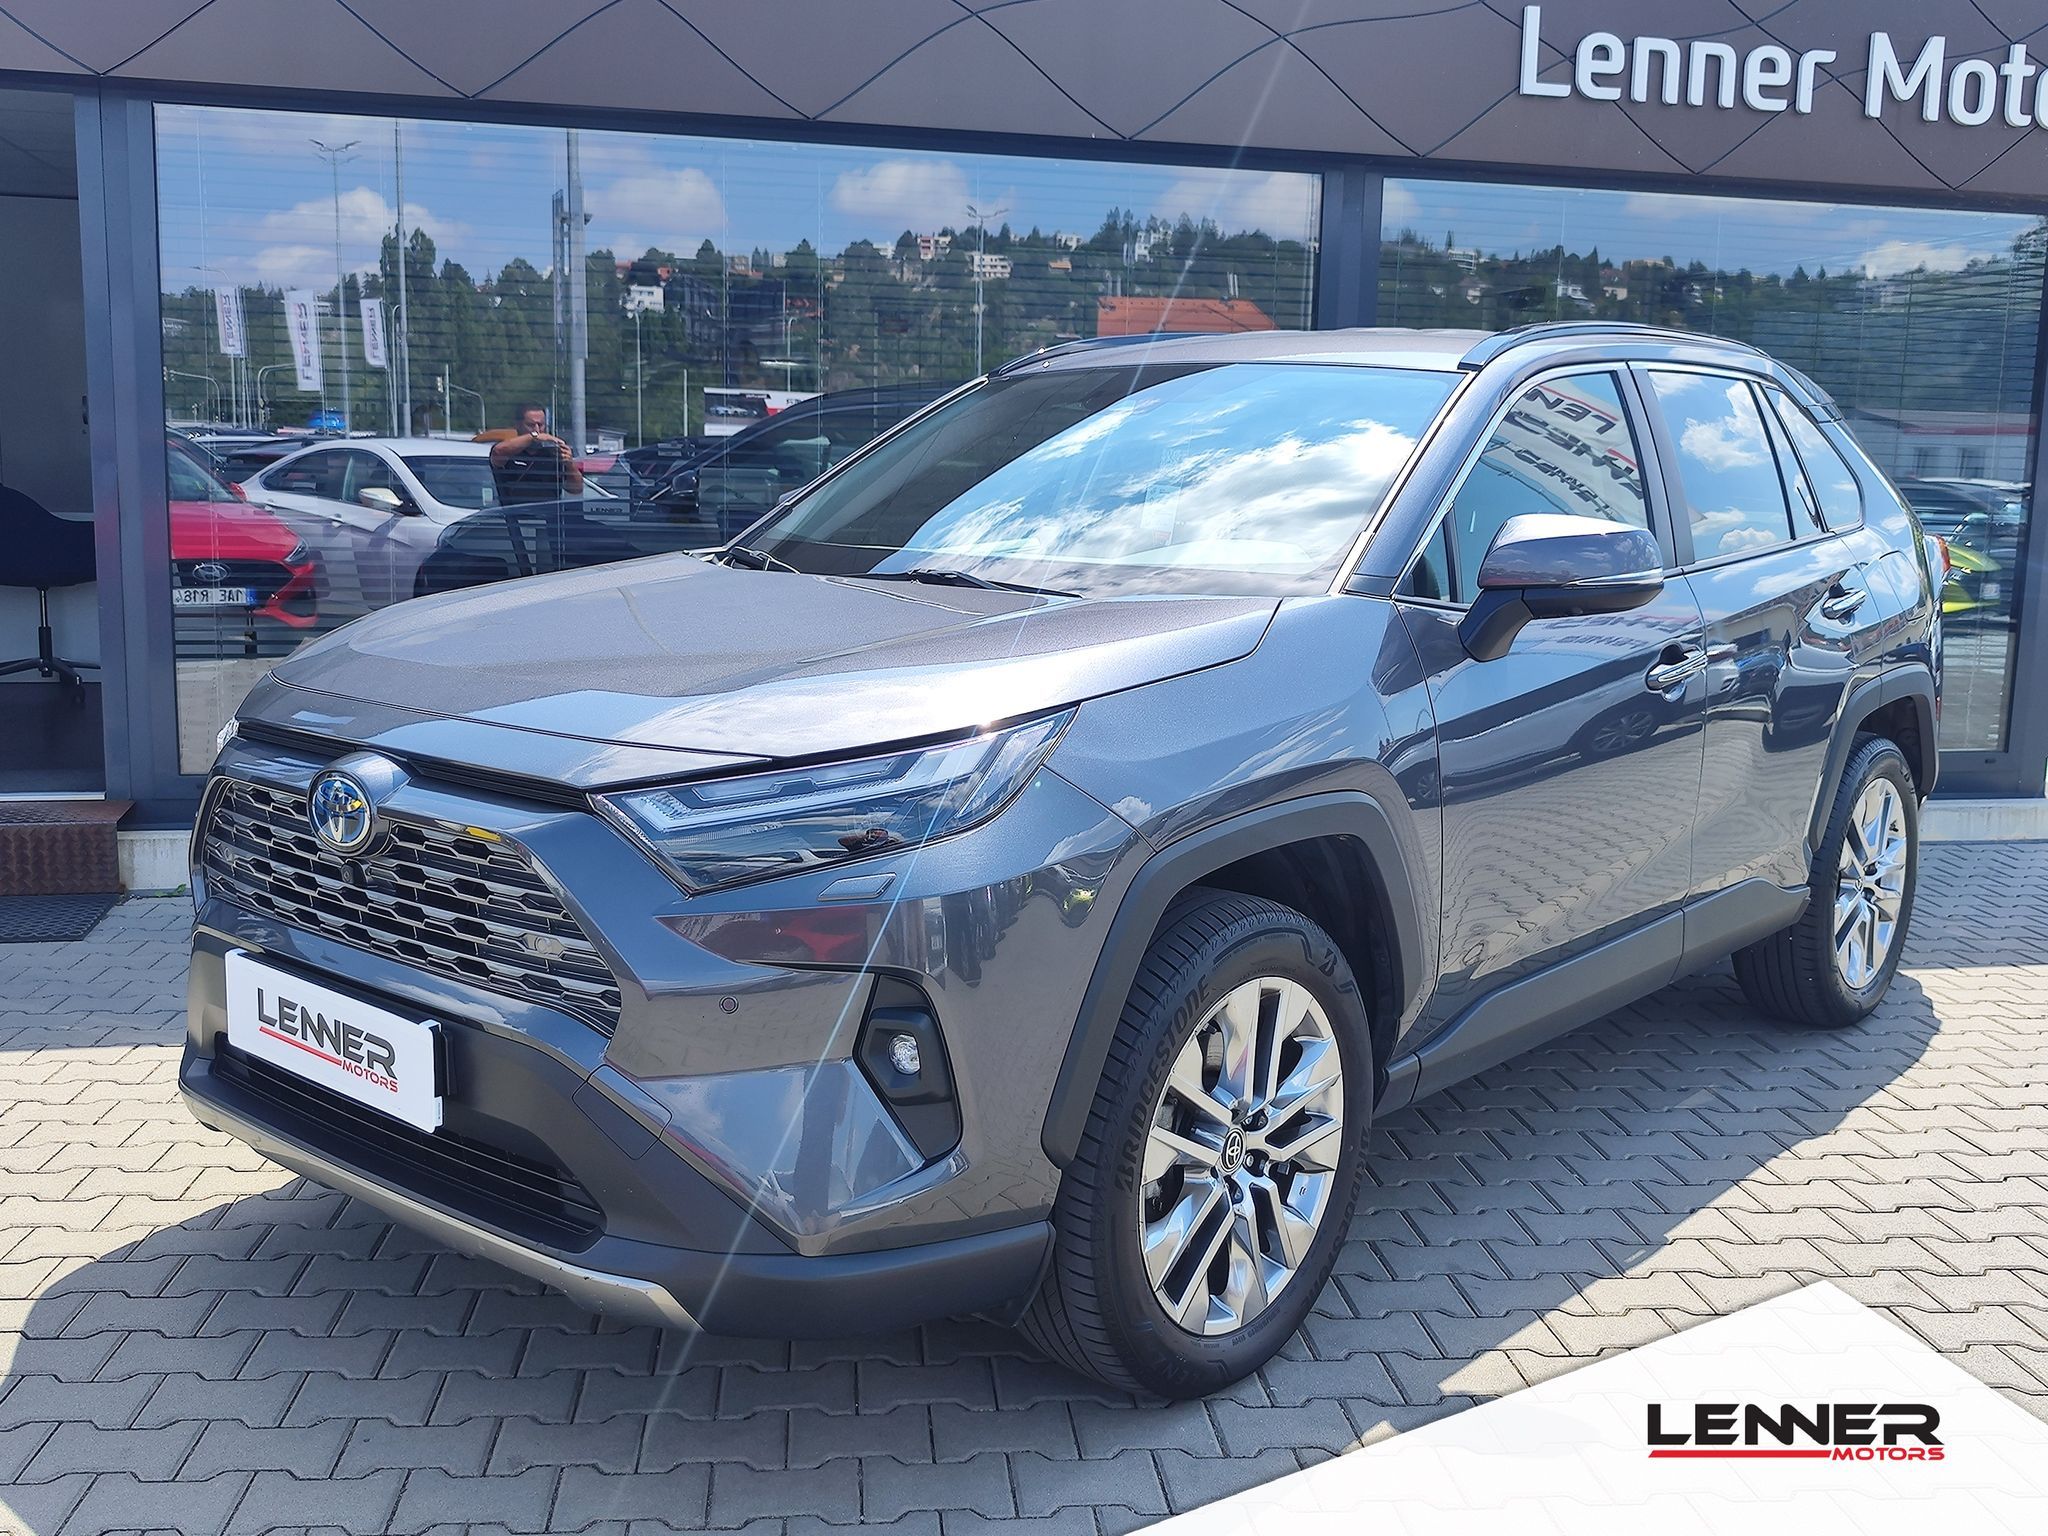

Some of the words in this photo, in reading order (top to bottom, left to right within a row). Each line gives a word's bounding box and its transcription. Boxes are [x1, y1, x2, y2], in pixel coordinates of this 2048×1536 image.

[1519, 5, 1837, 115] Lenner
[1864, 31, 2048, 131] Mot
[257, 987, 397, 1080] LENNER
[342, 1060, 399, 1093] MOTORS
[1115, 973, 1210, 1194] BRIDGESTONE
